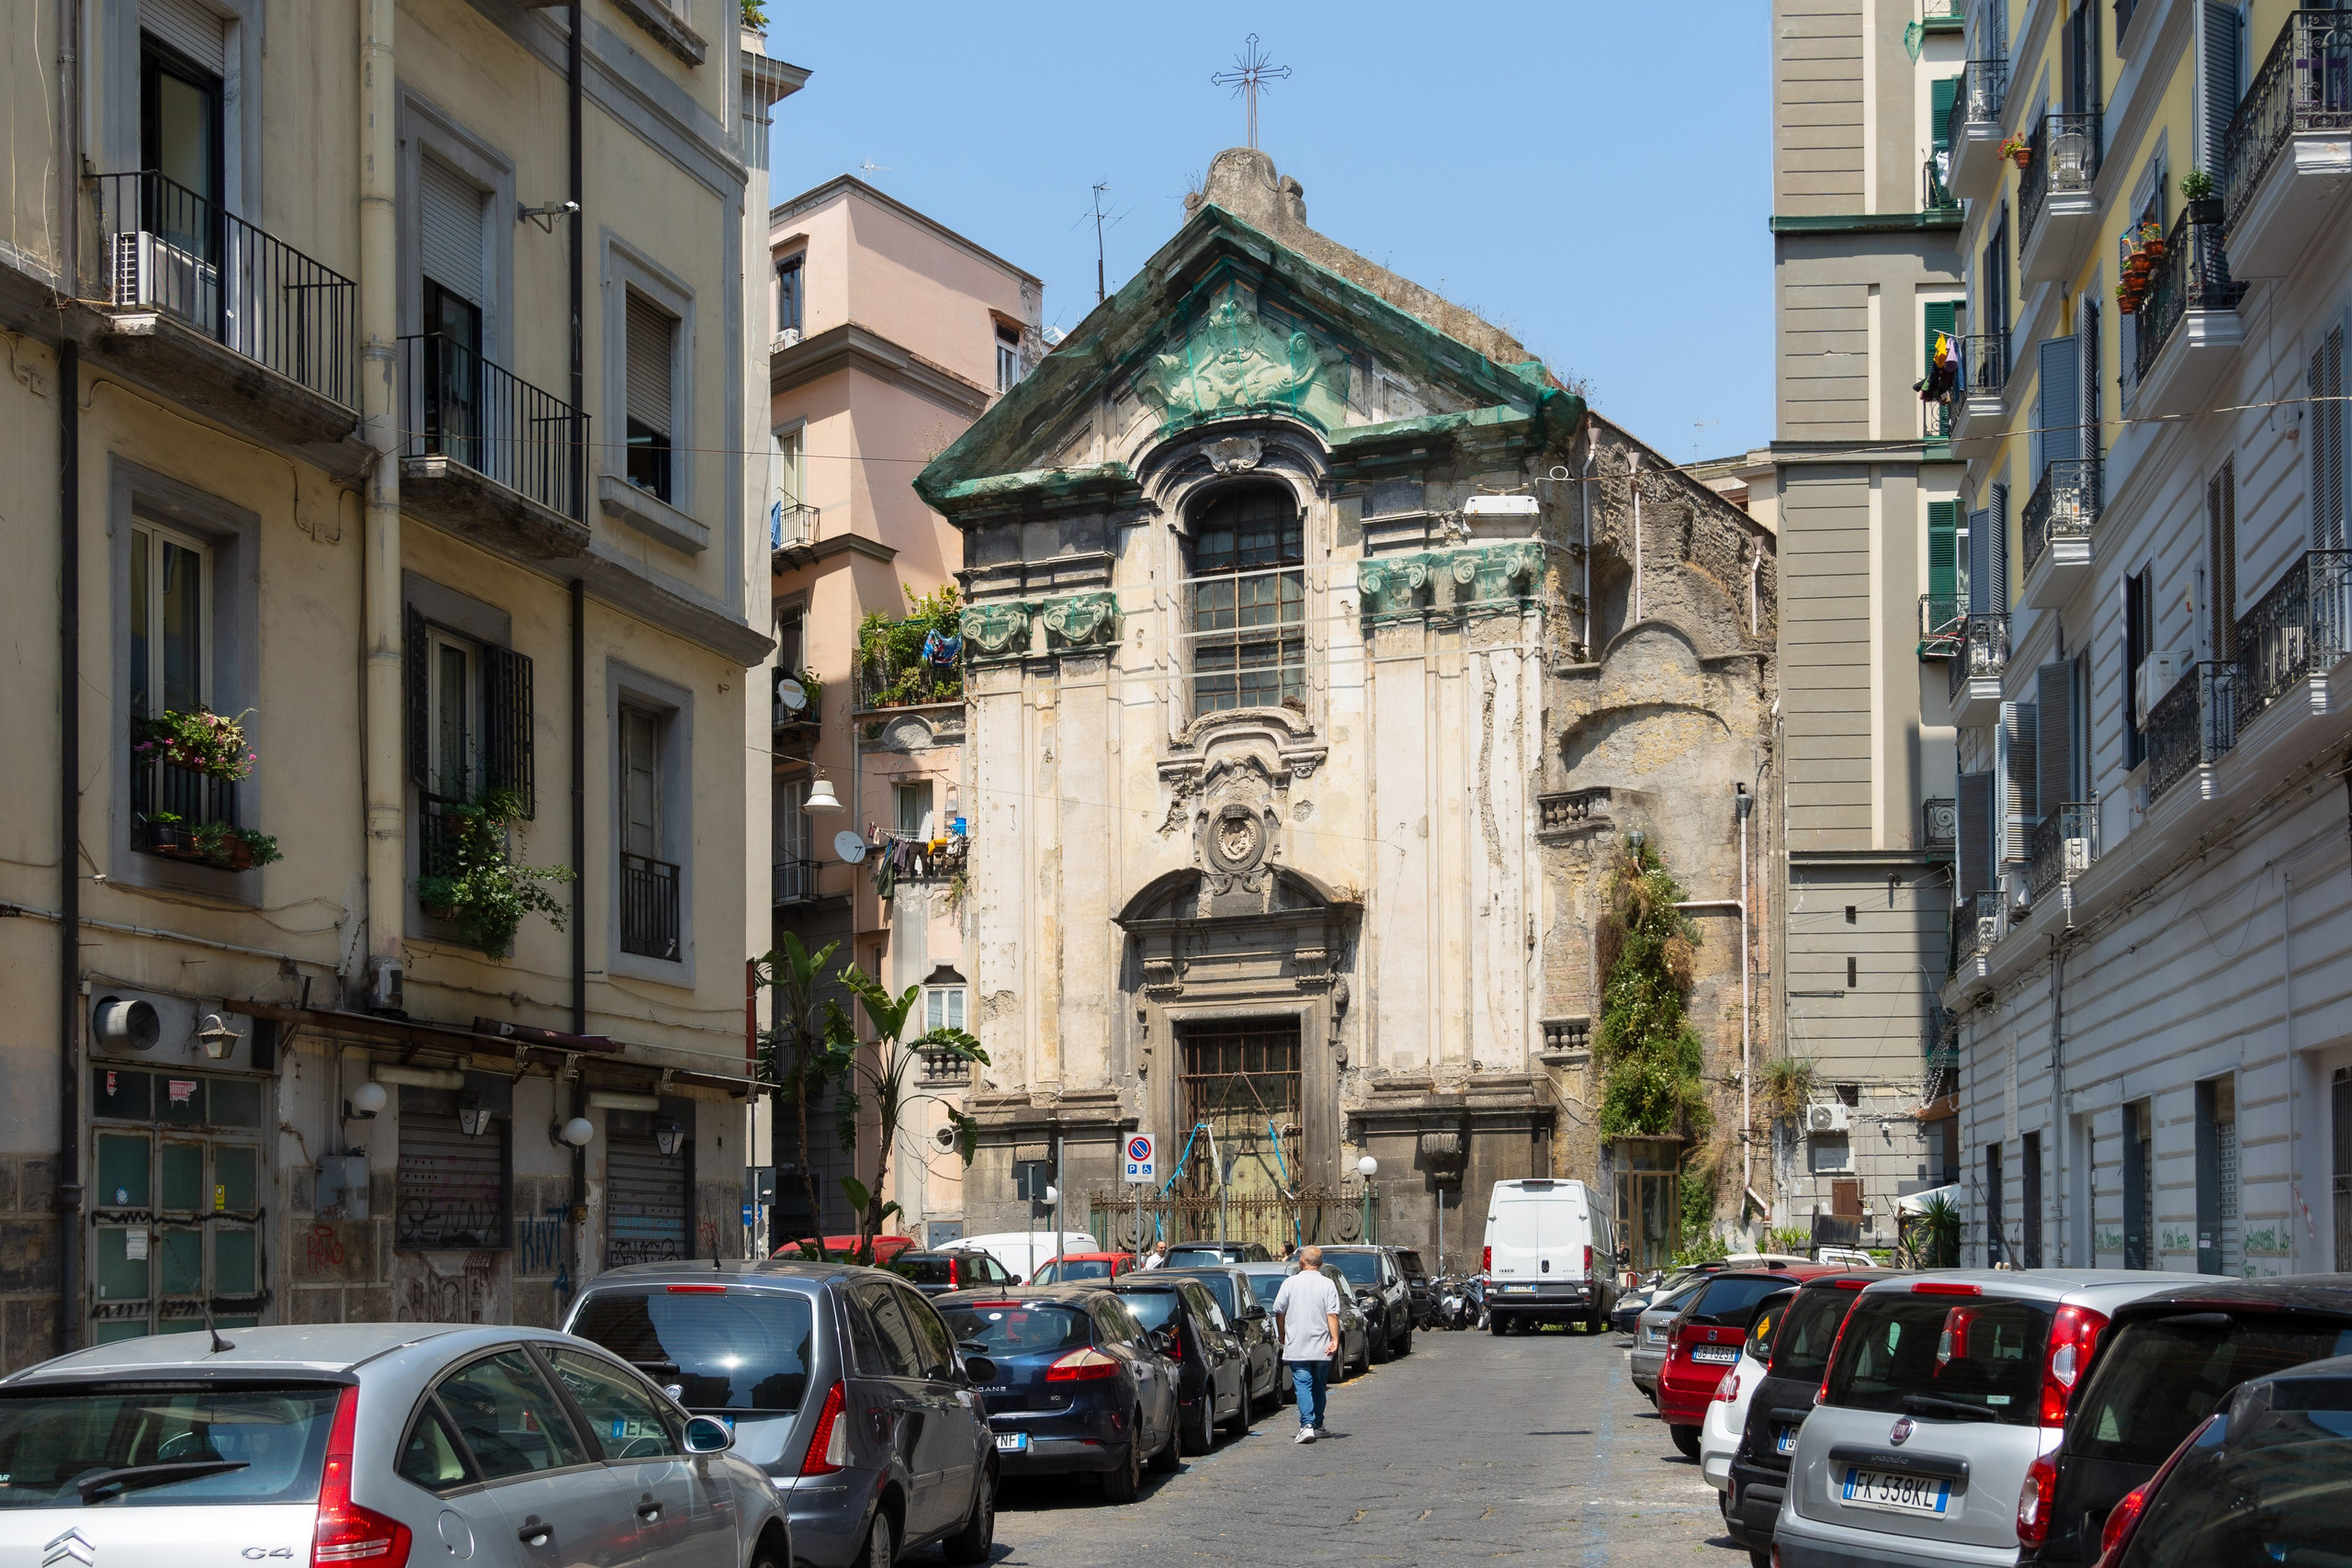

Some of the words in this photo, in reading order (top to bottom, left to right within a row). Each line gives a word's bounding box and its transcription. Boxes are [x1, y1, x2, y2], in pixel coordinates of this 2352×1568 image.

[1697, 1346, 1707, 1359] GB
[1709, 1347, 1736, 1360] 132SX
[1893, 1425, 1908, 1437] FIAT
[1853, 1472, 1877, 1499] FK
[1880, 1475, 1933, 1507] 538KL
[241, 1545, 294, 1560] C4
